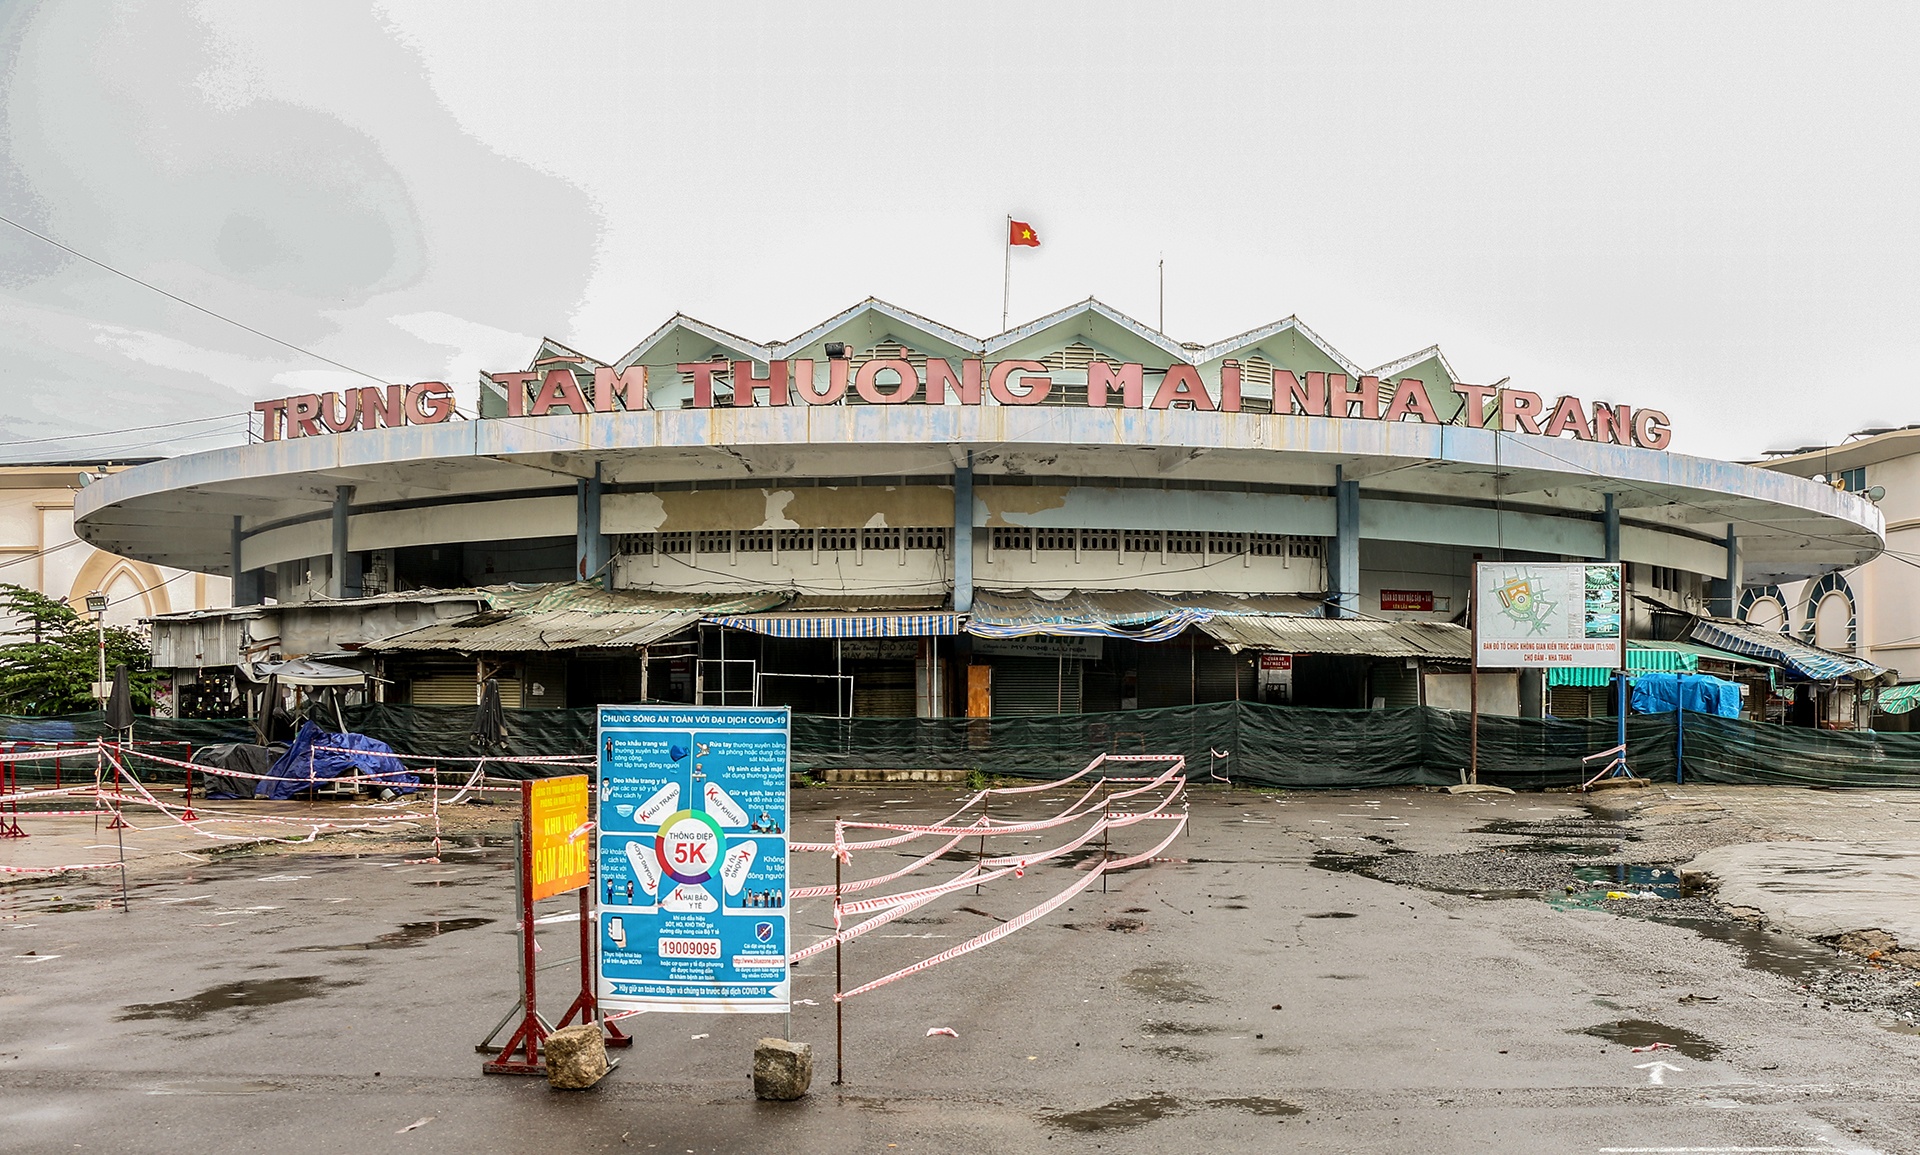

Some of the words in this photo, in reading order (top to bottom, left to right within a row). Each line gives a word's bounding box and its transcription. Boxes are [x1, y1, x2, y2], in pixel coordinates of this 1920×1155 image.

[254, 381, 456, 442] TRUNG
[492, 356, 649, 417] TÂM
[1272, 369, 1440, 423] NHA
[1451, 382, 1672, 450] TRANG
[671, 714, 693, 723] TOÀN
[695, 715, 709, 723] VỚI
[711, 717, 725, 725] ĐẠI
[728, 717, 747, 725] DỊCH
[660, 789, 679, 807] TRANG
[545, 816, 560, 836] KHU
[536, 838, 555, 885] CẤM
[576, 840, 586, 873] XE
[675, 843, 707, 863] 5K
[675, 889, 693, 901] KHAI
[663, 942, 716, 955] 19009095
